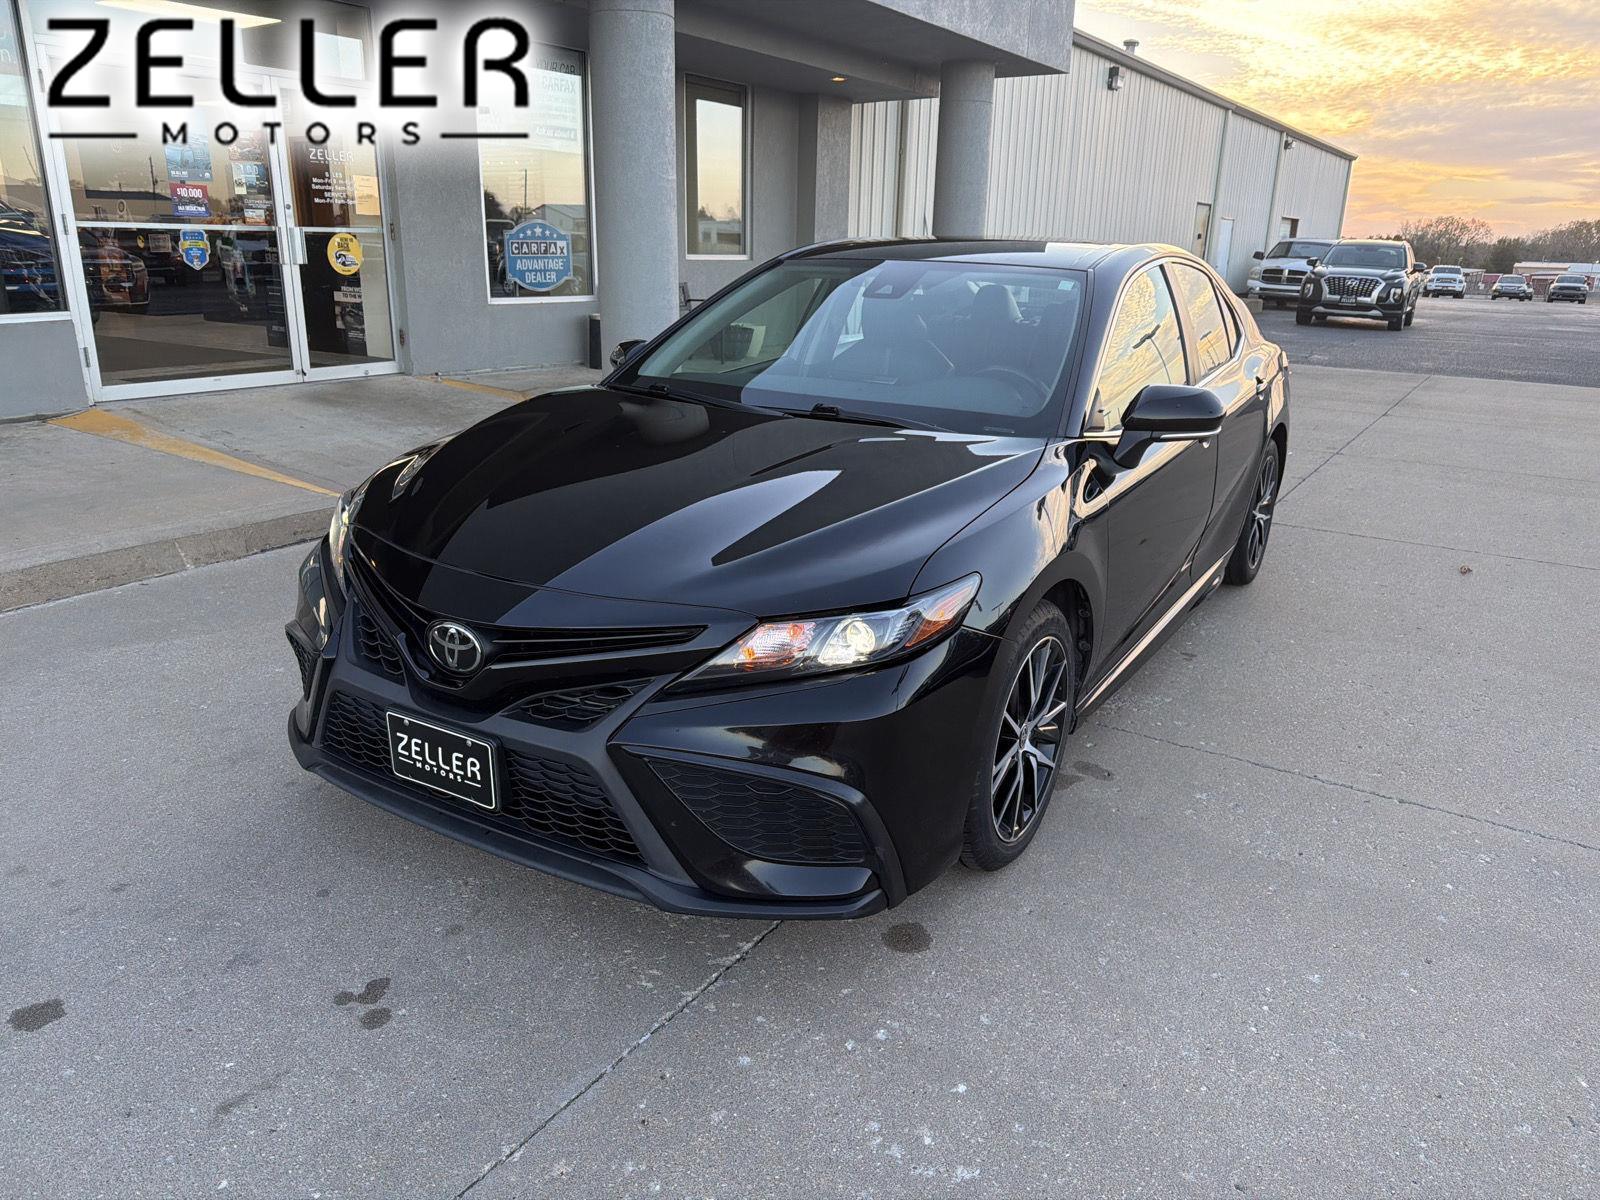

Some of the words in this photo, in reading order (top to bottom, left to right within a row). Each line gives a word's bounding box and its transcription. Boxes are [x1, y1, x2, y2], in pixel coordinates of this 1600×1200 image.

[309, 148, 354, 162] ZELLER
[311, 184, 334, 192] Saturday
[511, 241, 565, 256] CARFAX
[516, 258, 564, 270] ADVANTAGE
[525, 271, 557, 283] DEALER
[396, 732, 481, 781] ZELLER
[416, 761, 462, 782] MOTORS
